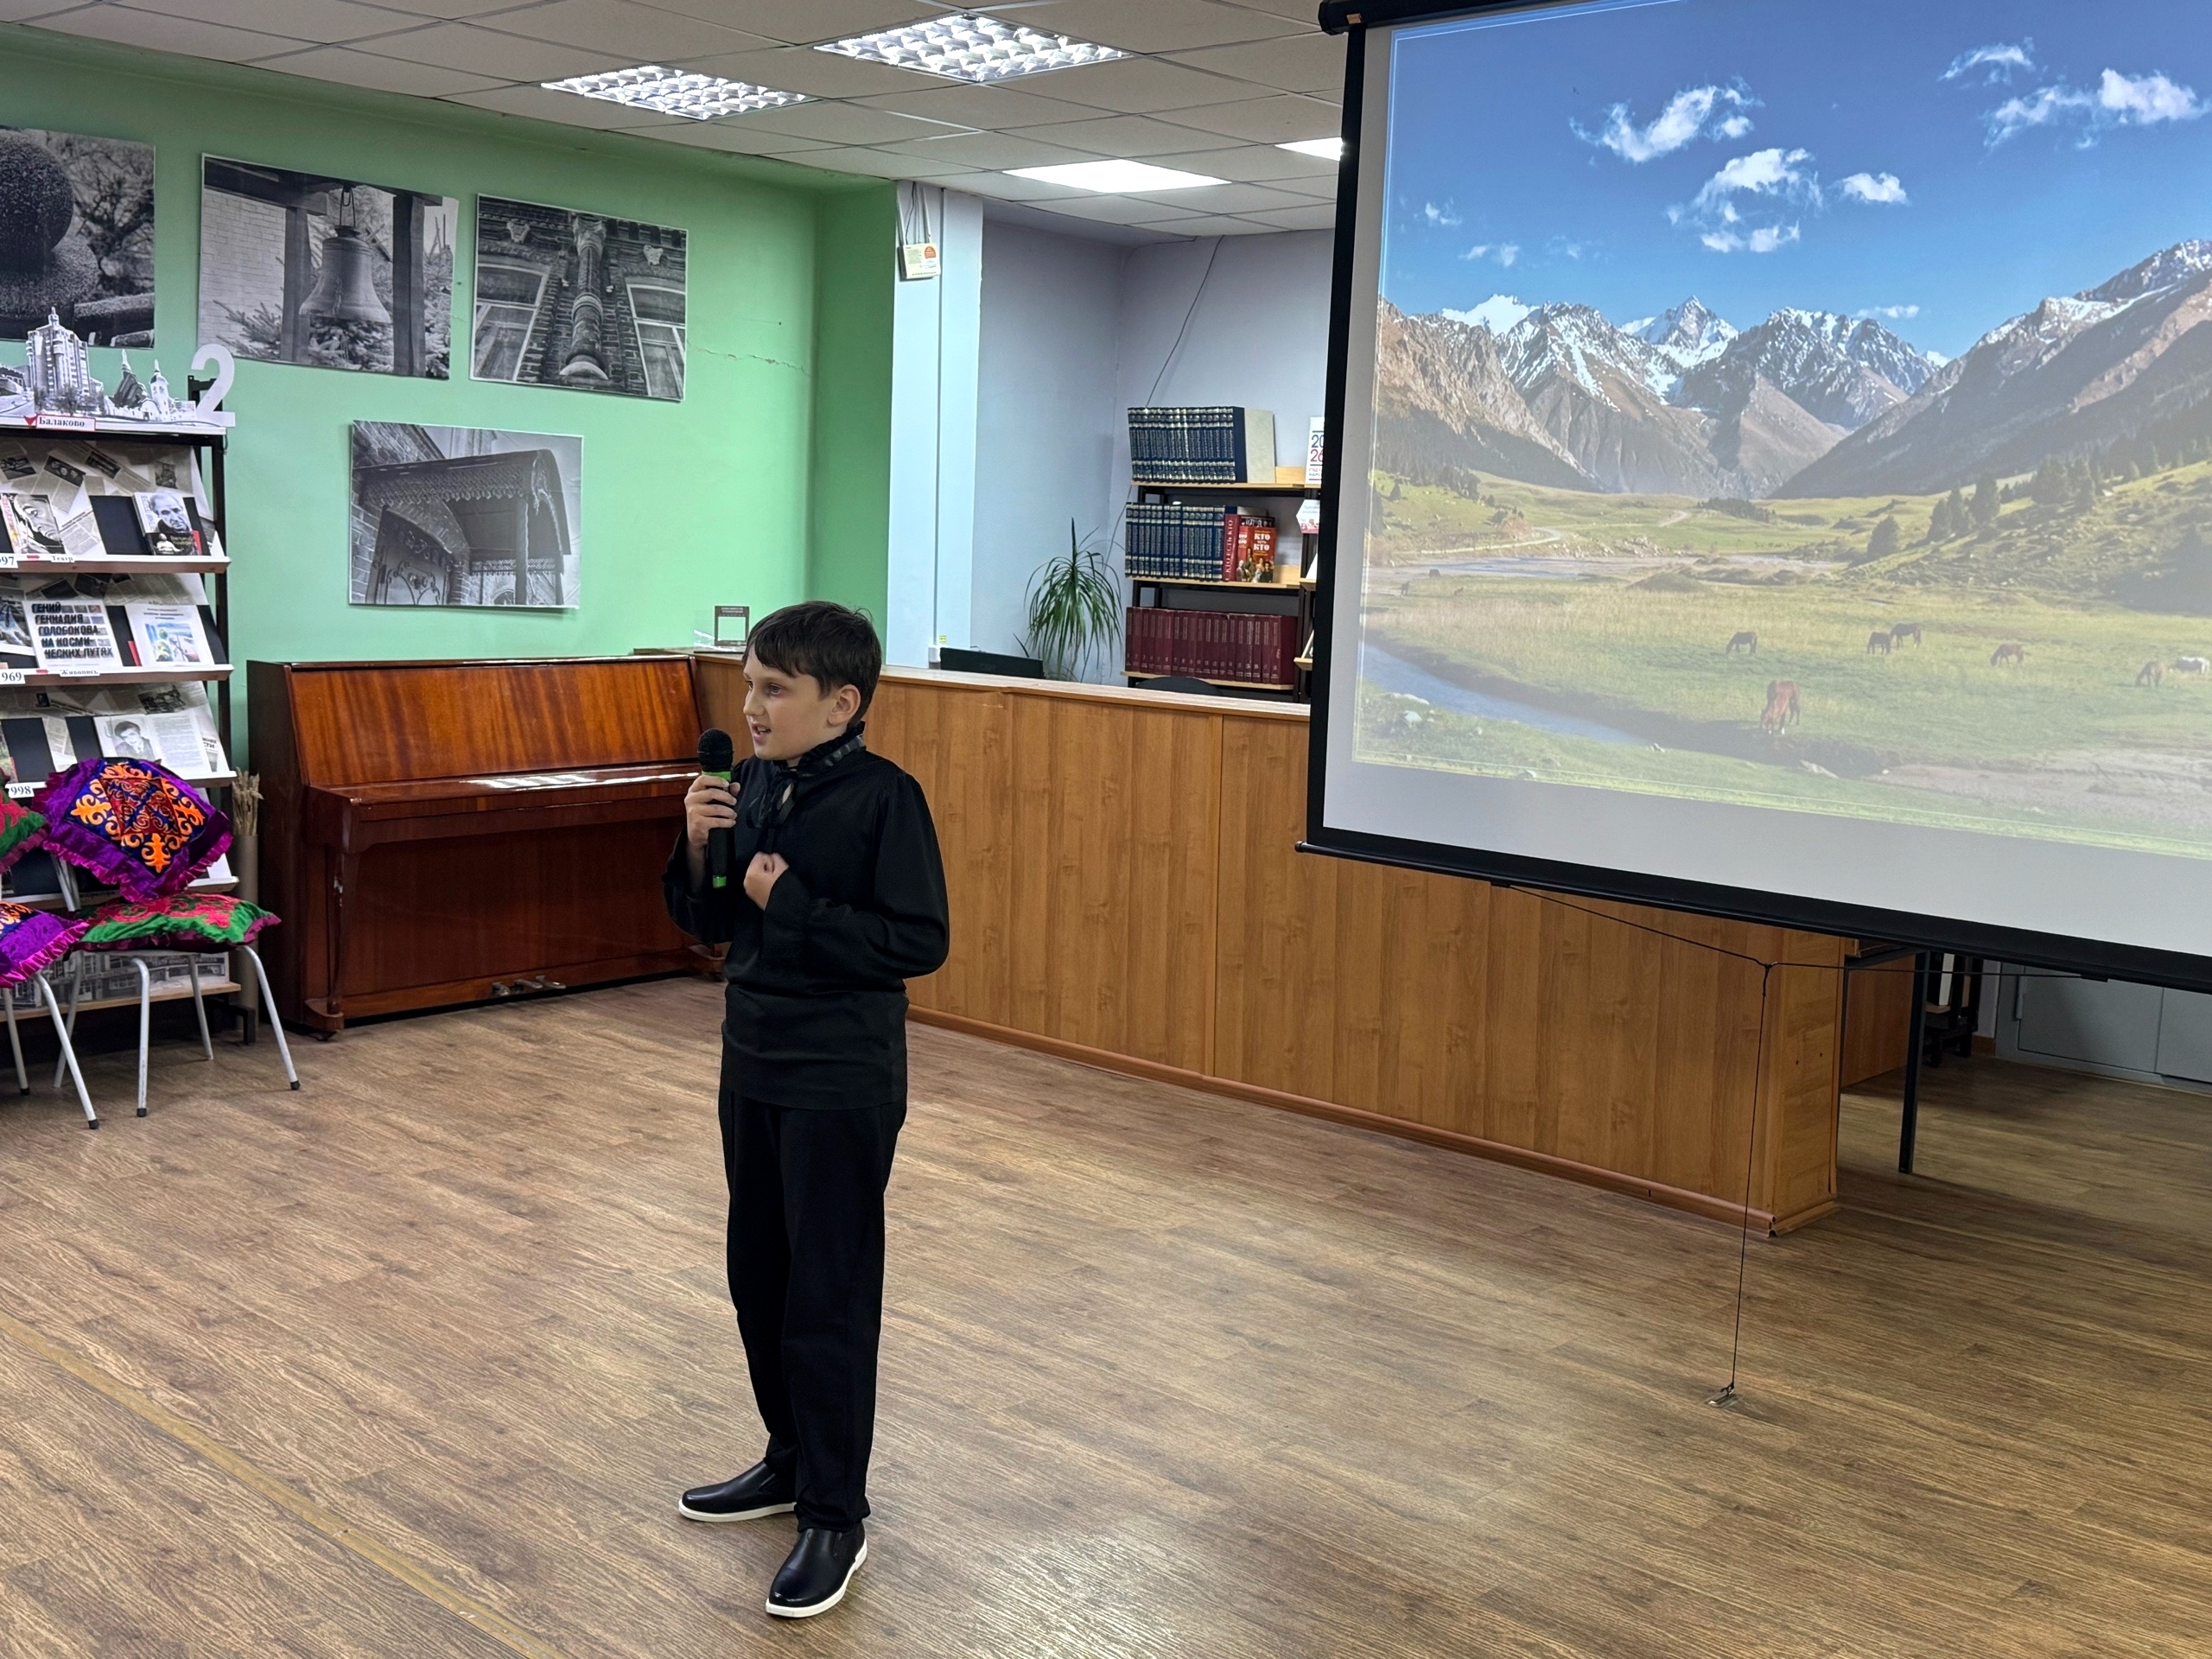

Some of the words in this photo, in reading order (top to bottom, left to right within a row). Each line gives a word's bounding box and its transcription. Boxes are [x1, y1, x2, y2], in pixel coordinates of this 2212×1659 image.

[191, 343, 236, 428] 2
[39, 416, 85, 428] Балаково
[0, 556, 15, 566] 97
[31, 602, 61, 613] ГЕНИЙ
[35, 613, 84, 625] ГЕННАДИЯ
[38, 625, 99, 636] ГОЛОБОКОВА
[41, 638, 55, 647] НА
[44, 648, 81, 659] ЧЕСКИХ
[82, 646, 114, 659] ПУТЯХ
